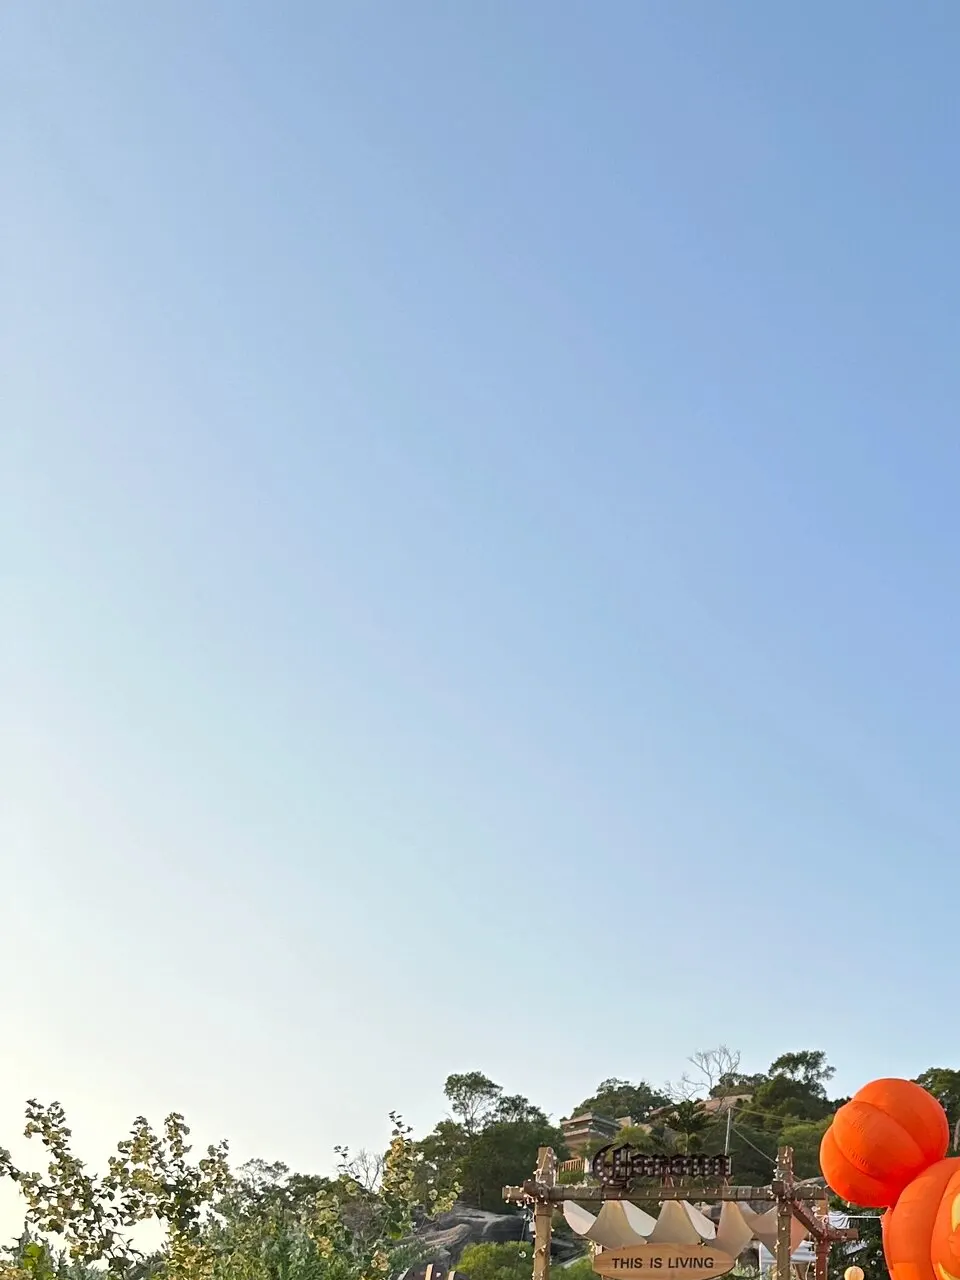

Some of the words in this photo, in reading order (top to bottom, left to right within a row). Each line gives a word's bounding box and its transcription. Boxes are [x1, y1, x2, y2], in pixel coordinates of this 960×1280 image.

[611, 1257, 643, 1269] THIS
[650, 1257, 663, 1269] IS
[668, 1257, 714, 1269] LIVING
